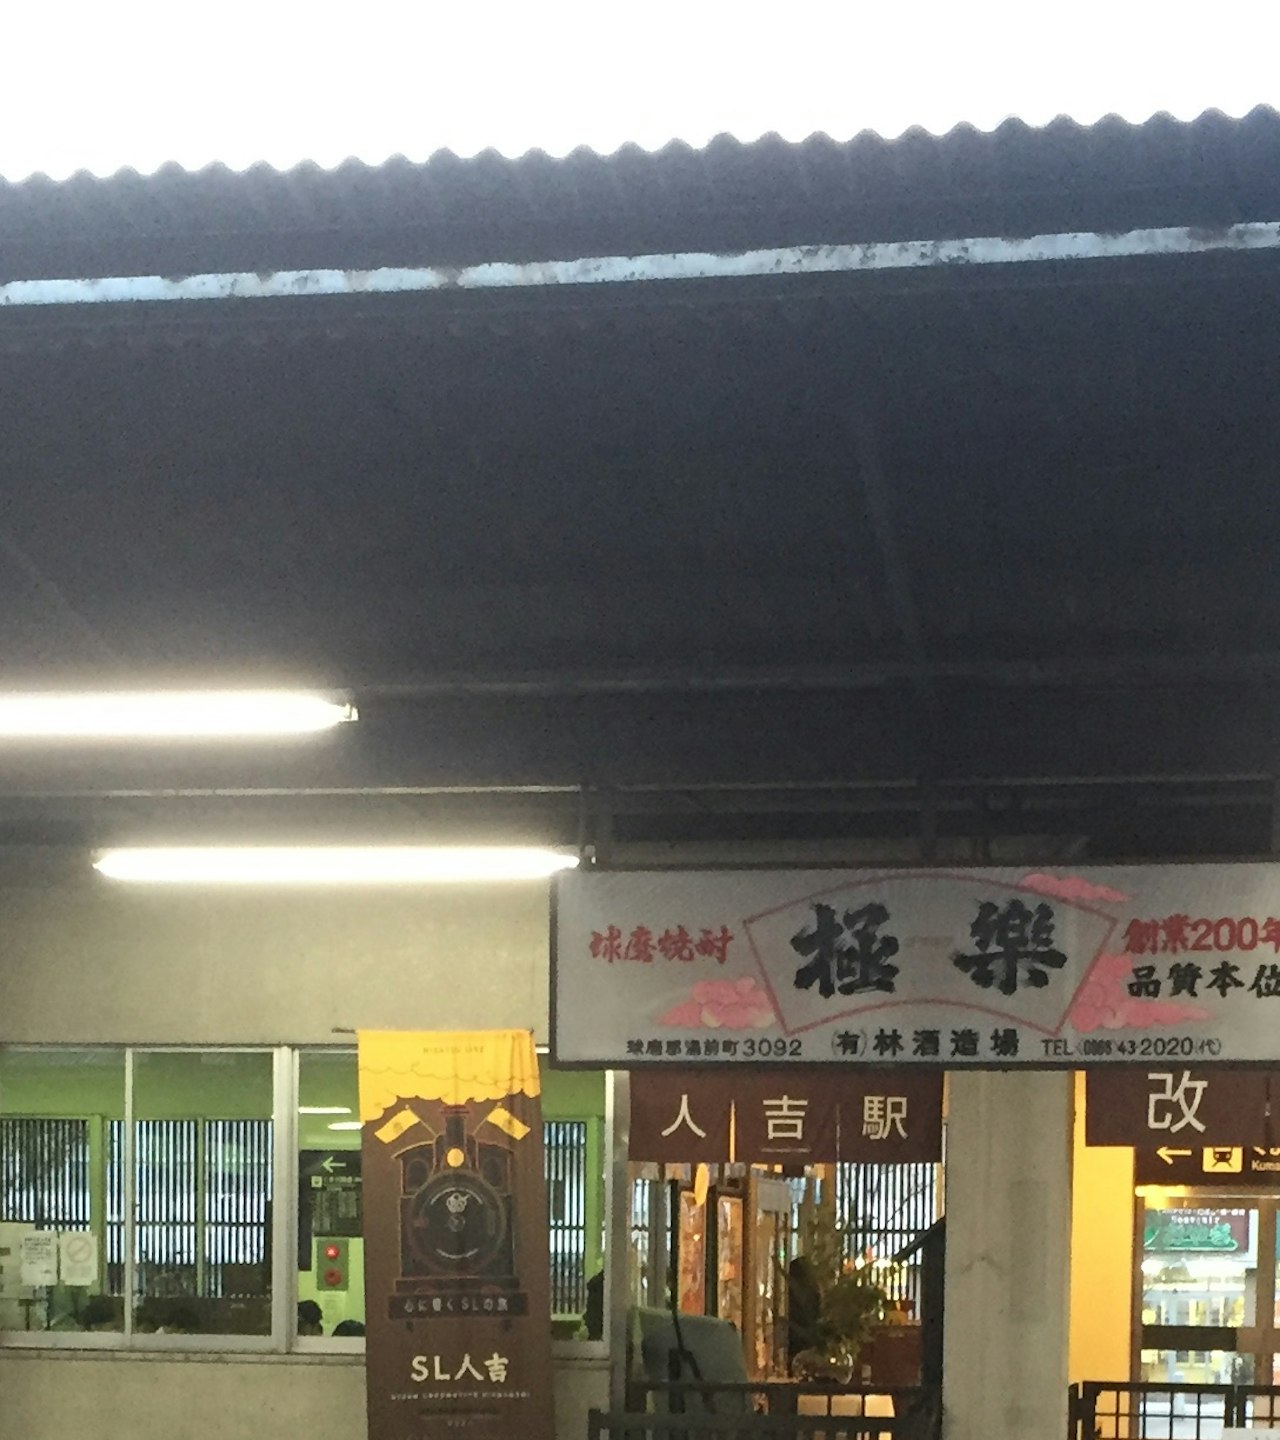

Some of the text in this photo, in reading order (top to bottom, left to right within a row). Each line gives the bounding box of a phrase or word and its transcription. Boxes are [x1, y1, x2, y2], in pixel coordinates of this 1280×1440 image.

[661, 1094, 909, 1140] 人吉駅
[410, 1351, 509, 1383] SL人吉
